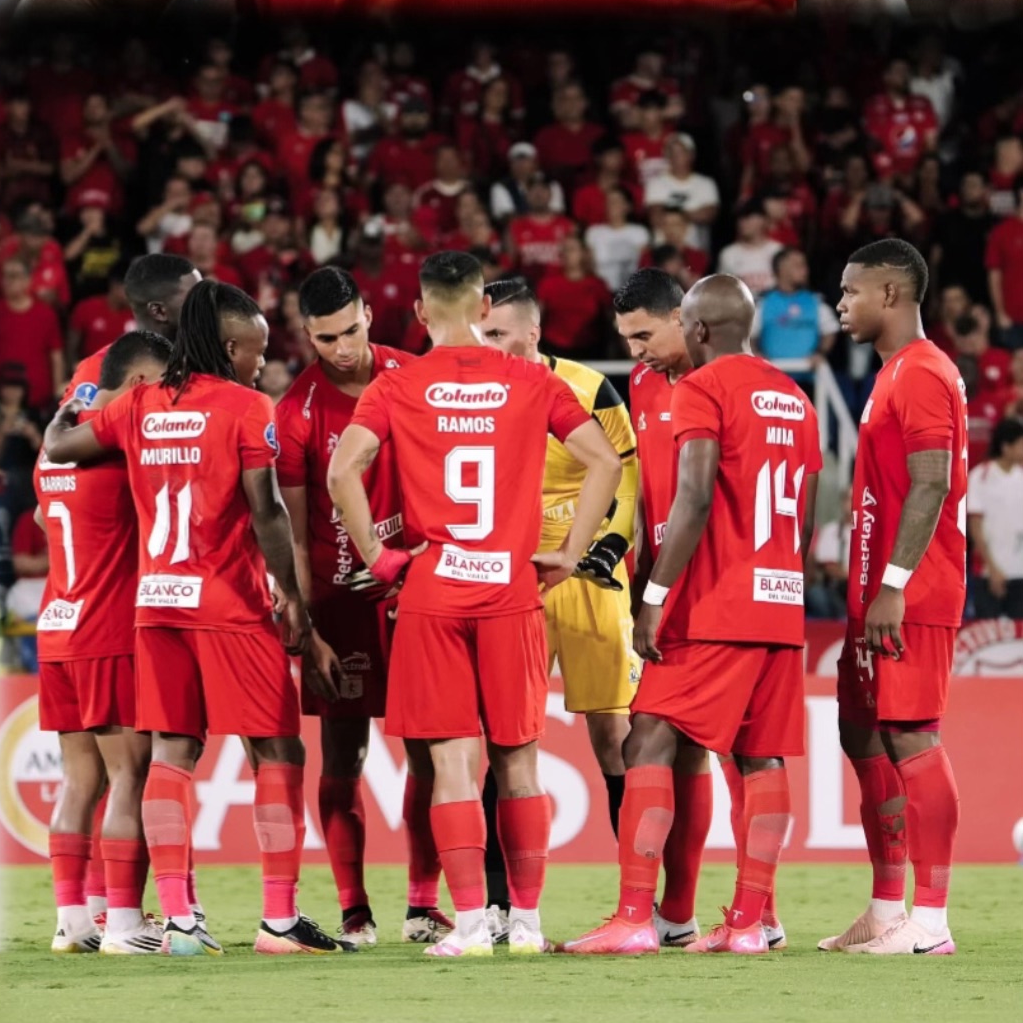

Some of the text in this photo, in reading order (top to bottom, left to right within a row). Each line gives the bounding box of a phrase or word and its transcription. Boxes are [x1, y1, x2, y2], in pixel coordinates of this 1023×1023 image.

[428, 386, 505, 403] Colanta
[142, 417, 203, 433] Colanta
[437, 416, 495, 433] RAMOS
[140, 447, 201, 465] MURILLO
[444, 445, 495, 540] 9
[754, 459, 806, 555] 14
[147, 480, 192, 565] 11
[47, 501, 76, 593] 7
[859, 508, 876, 586] BetPlay
[445, 554, 504, 572] BLANCO
[140, 584, 194, 597] BLANCO
[761, 578, 802, 594] BLANCO
